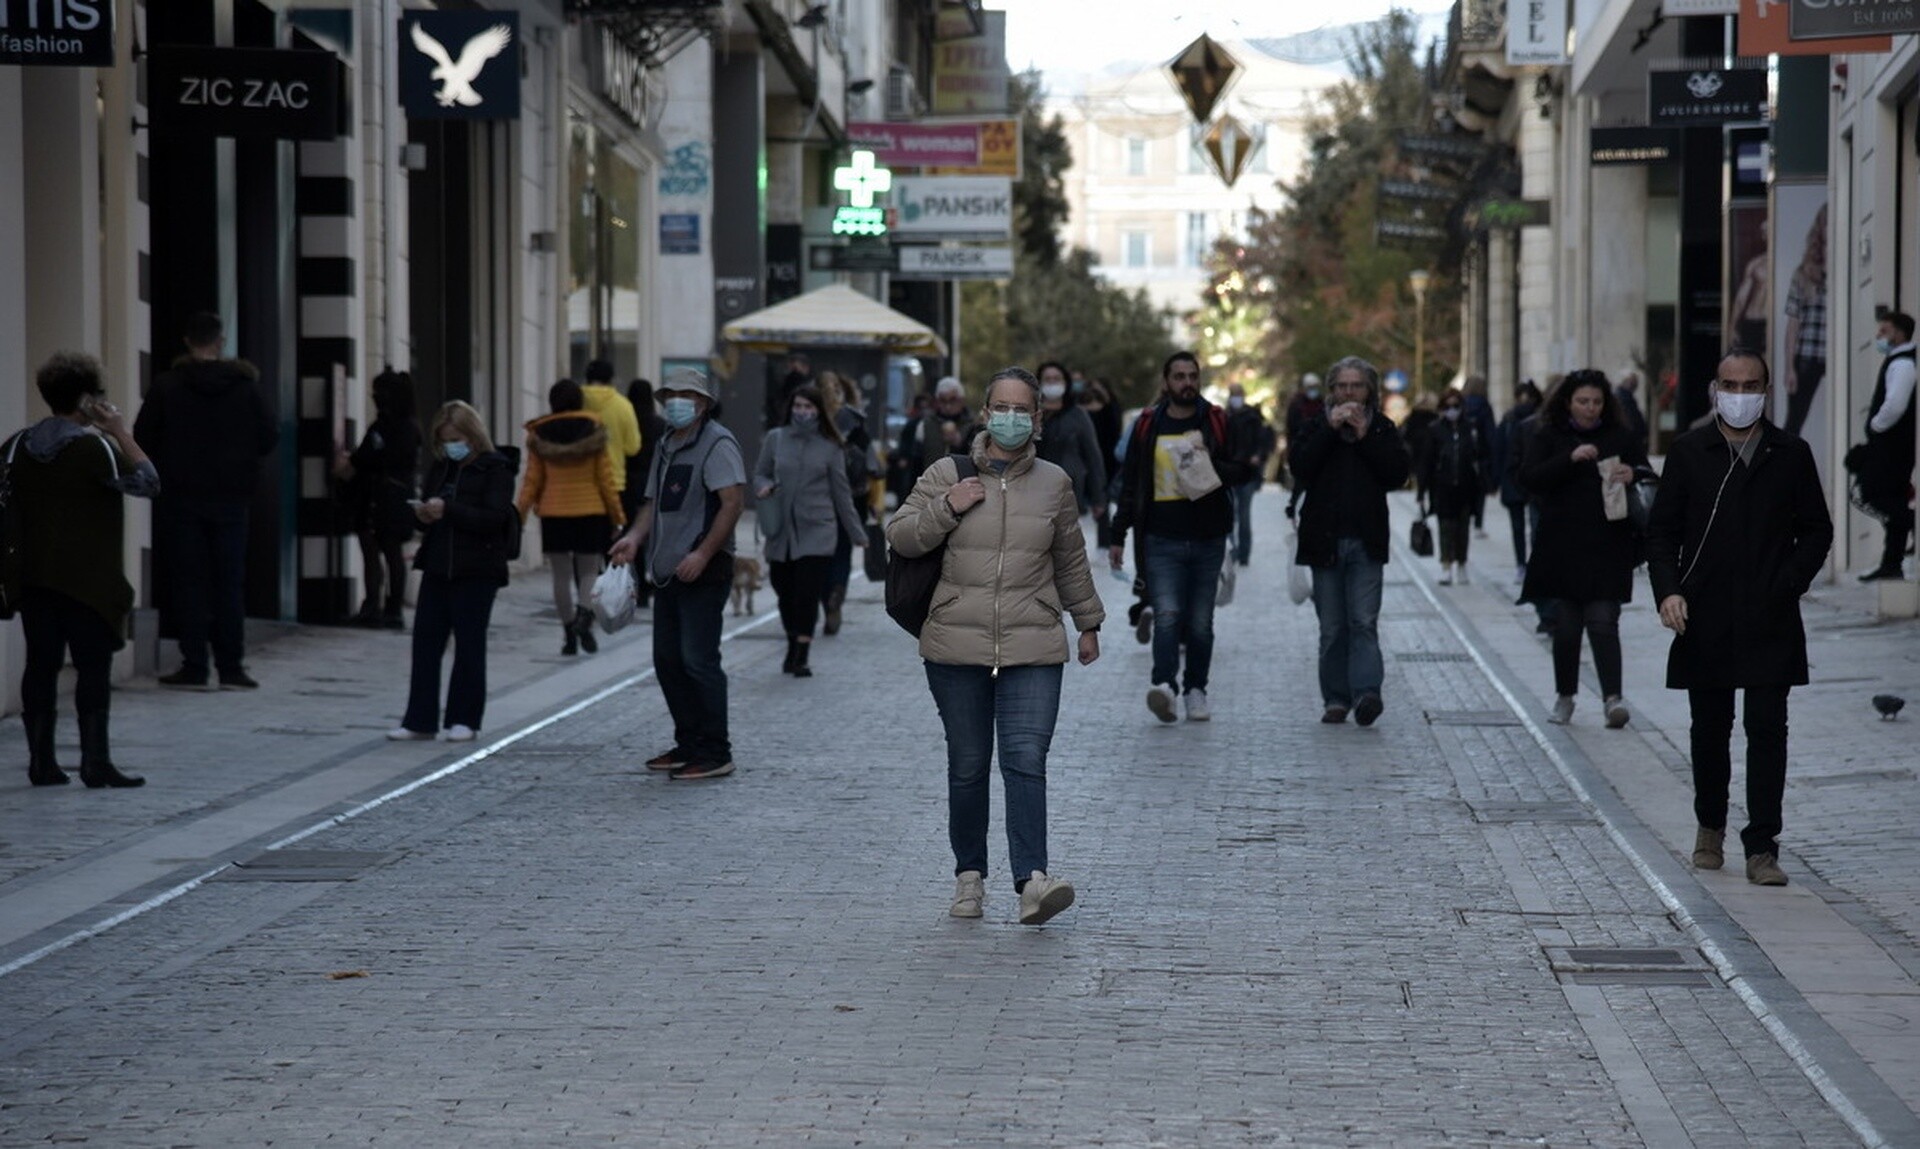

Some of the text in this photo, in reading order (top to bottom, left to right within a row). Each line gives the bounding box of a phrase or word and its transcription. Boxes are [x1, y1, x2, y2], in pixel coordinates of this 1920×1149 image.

[0, 34, 83, 54] fashion
[179, 78, 310, 110] ZIC ZAC
